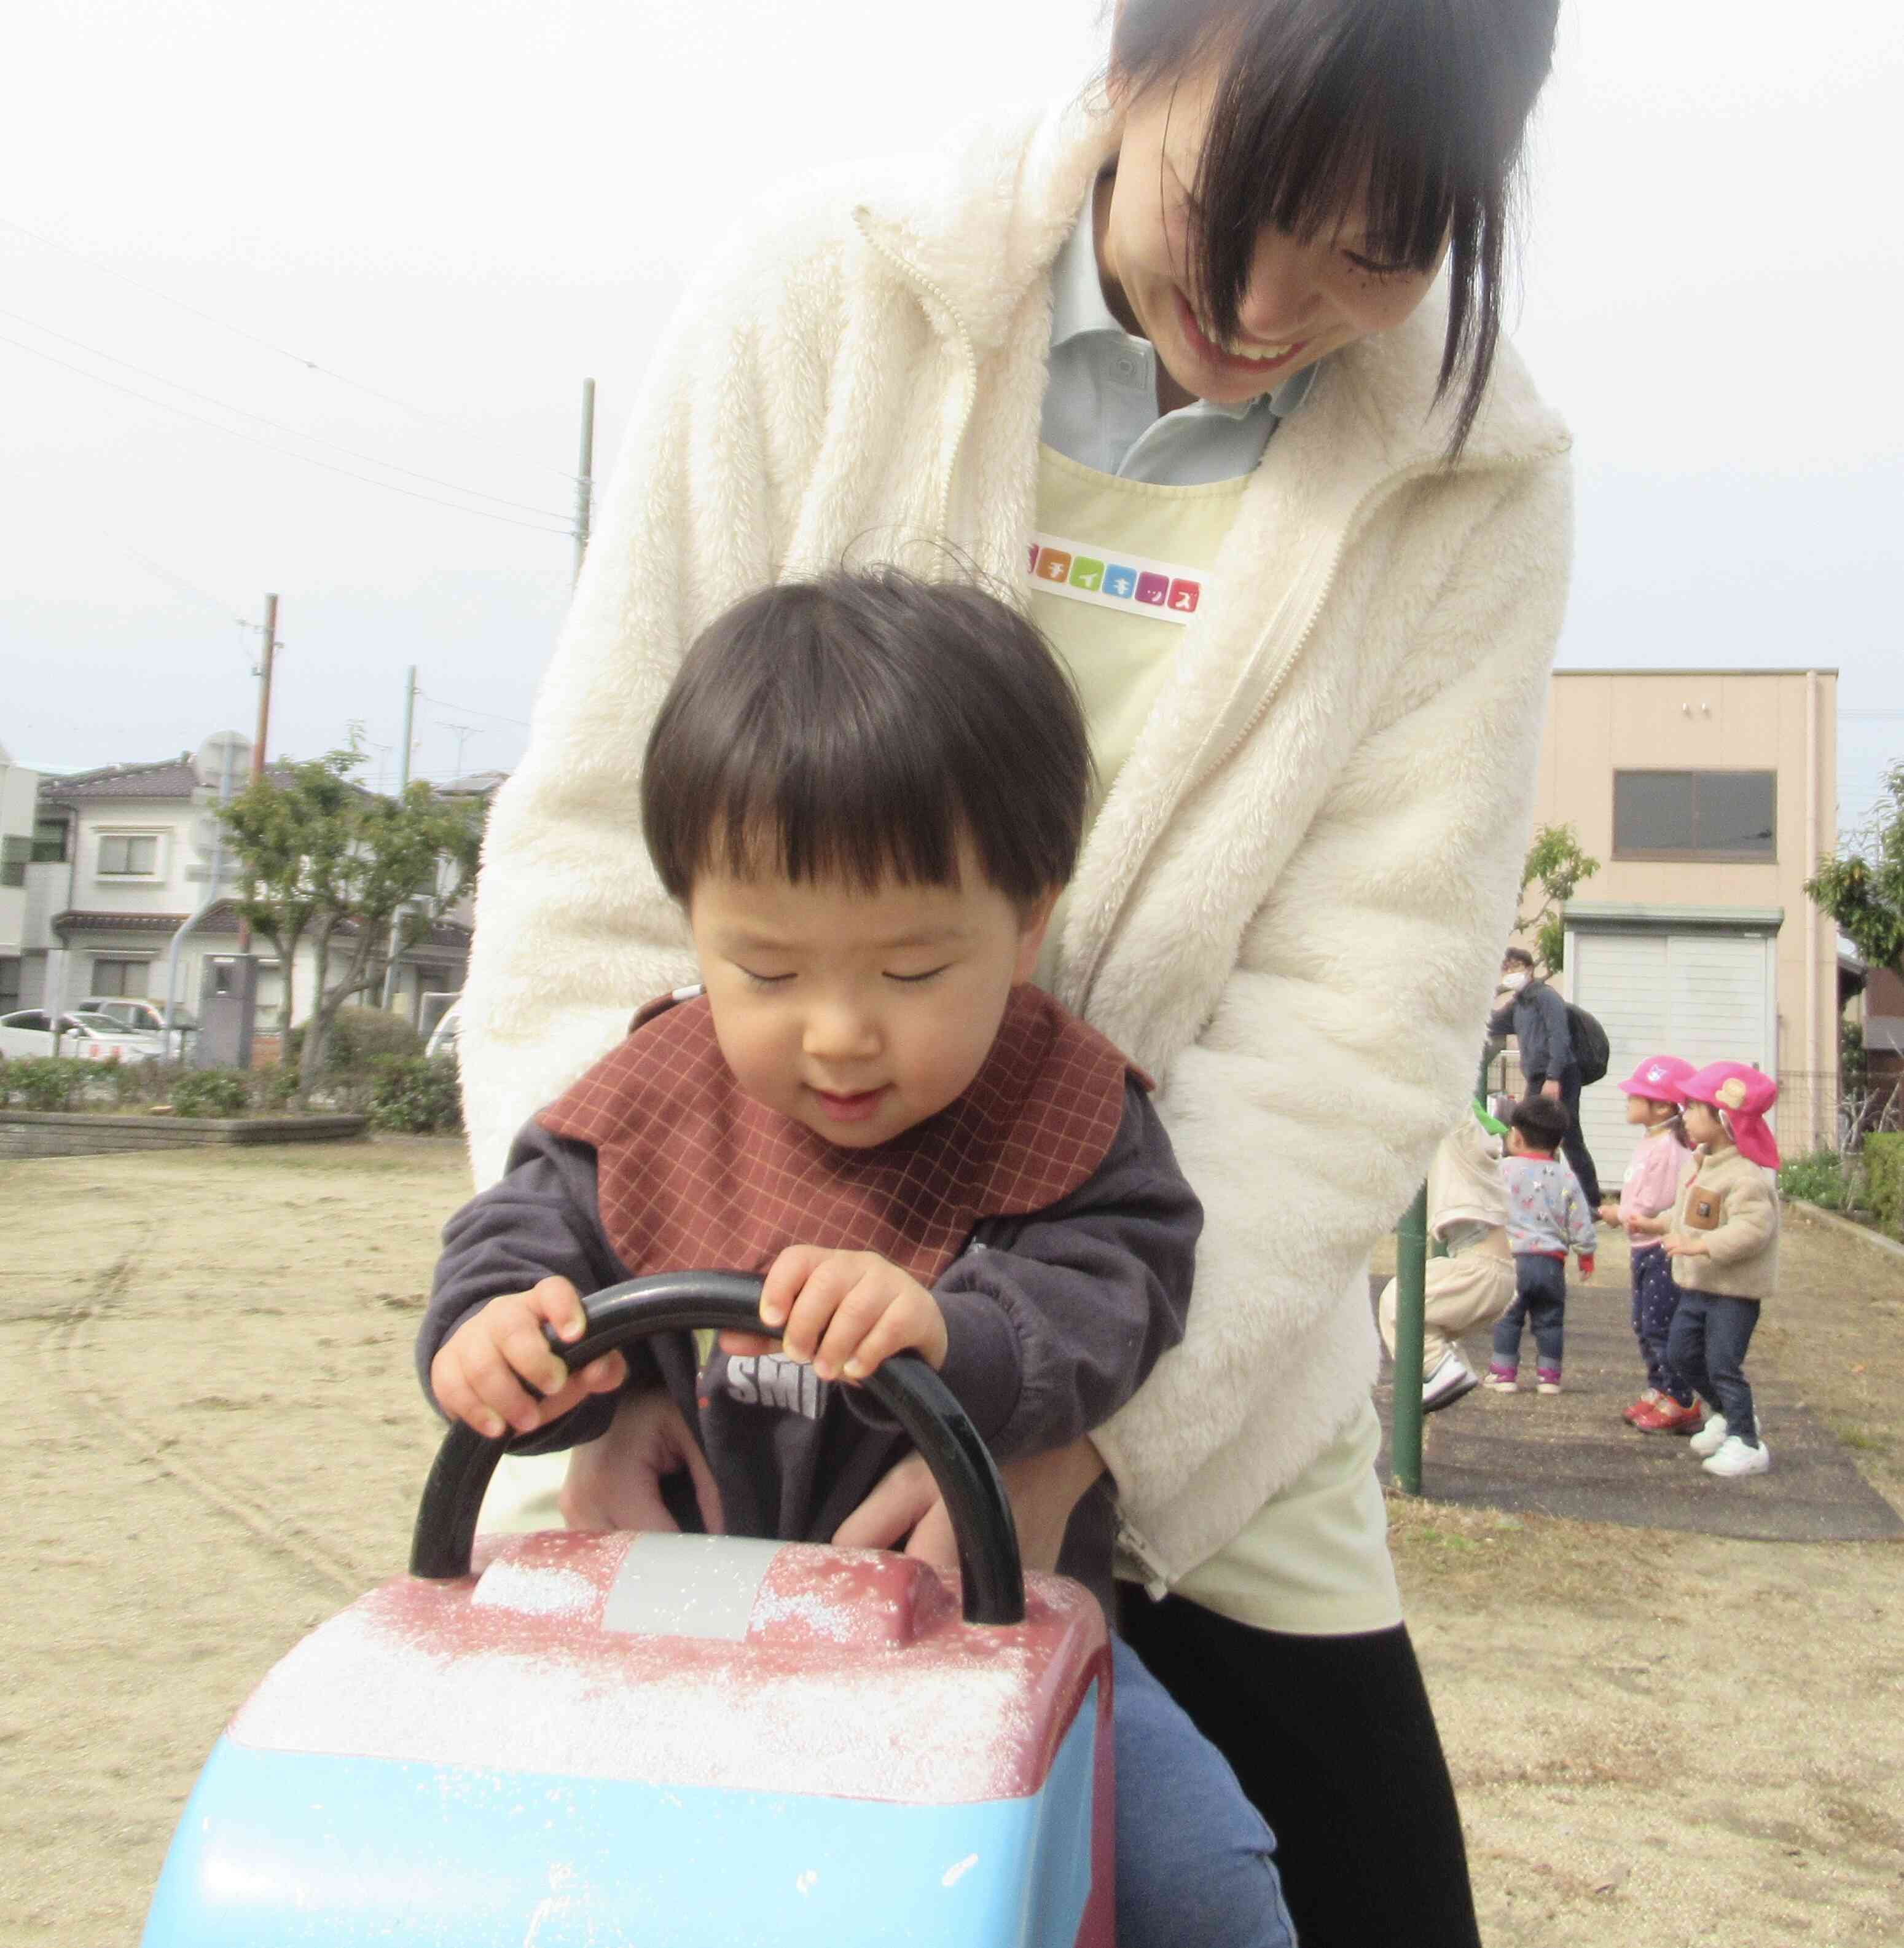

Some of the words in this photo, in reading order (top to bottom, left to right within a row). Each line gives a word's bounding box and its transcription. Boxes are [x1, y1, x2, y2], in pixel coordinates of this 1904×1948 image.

[1035, 548, 1201, 613] チイキッズ
[727, 1353, 821, 1419] SMI
